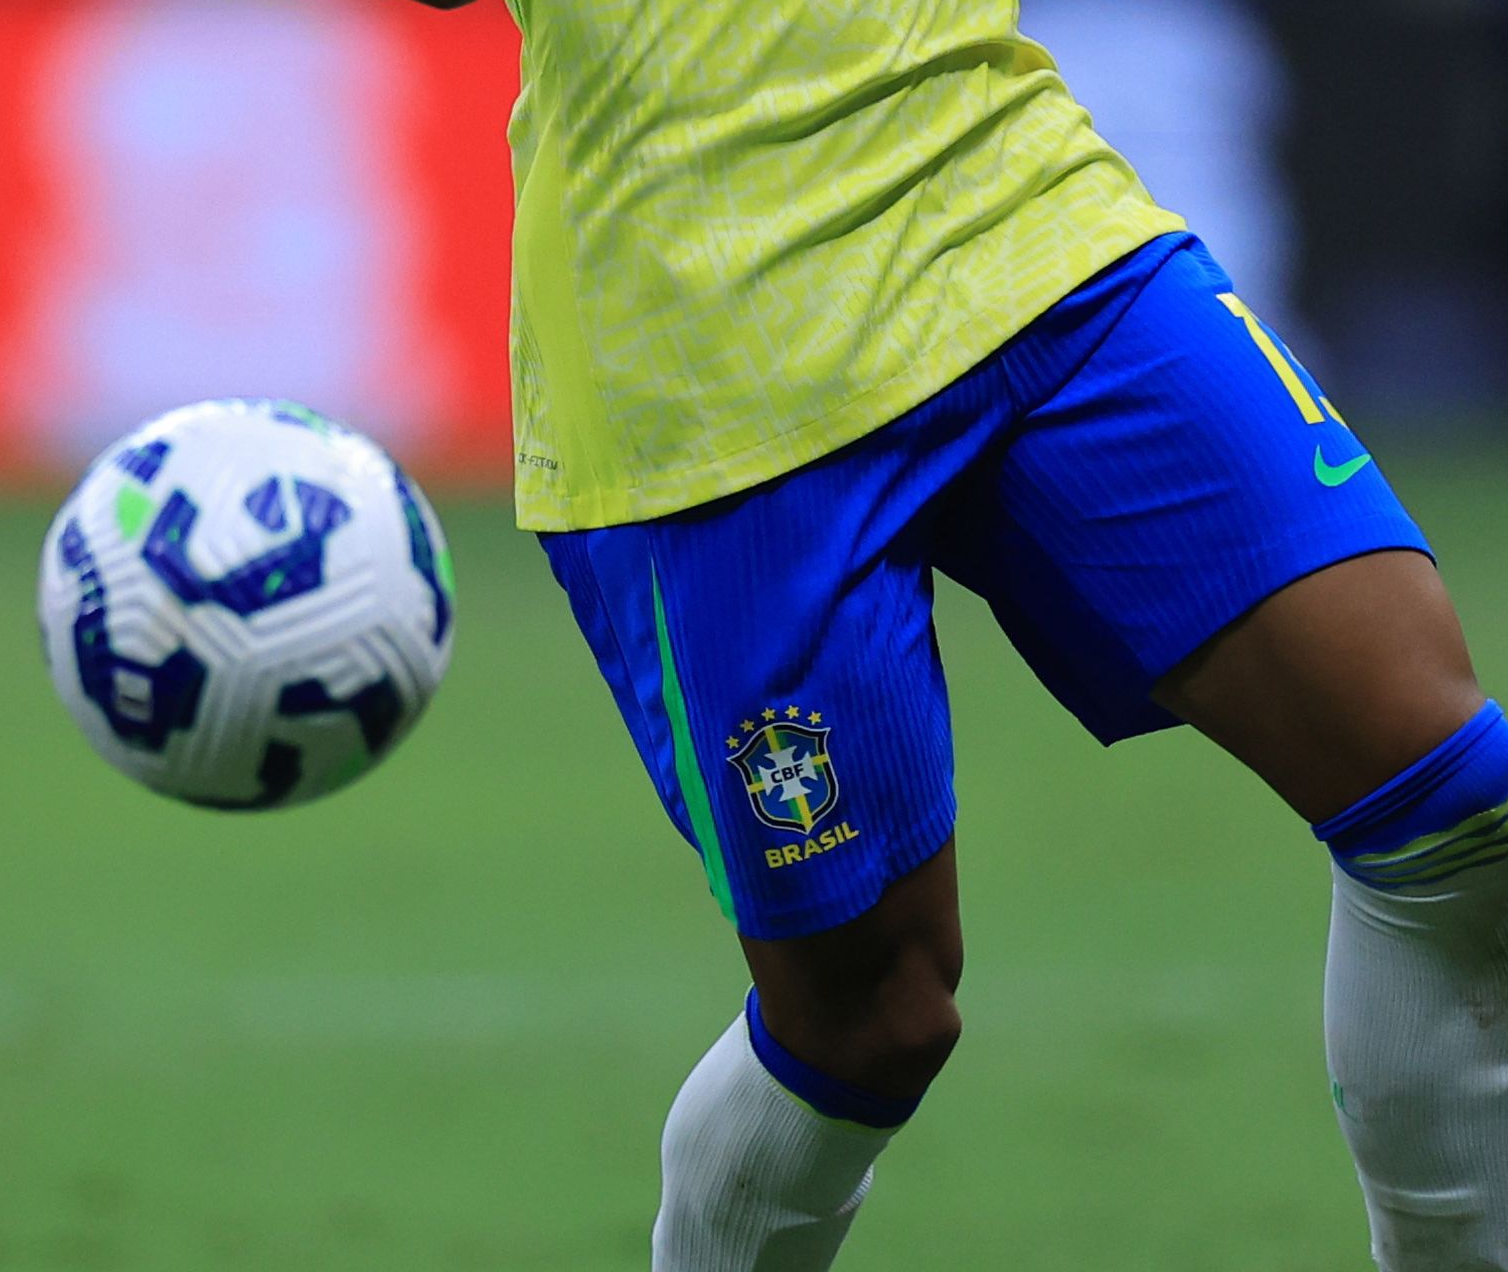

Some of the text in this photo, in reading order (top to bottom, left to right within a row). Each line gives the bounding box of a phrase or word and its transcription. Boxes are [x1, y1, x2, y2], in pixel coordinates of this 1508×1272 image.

[1214, 292, 1350, 430] 1
[770, 763, 805, 784] CBF
[764, 821, 860, 869] BRASIL
